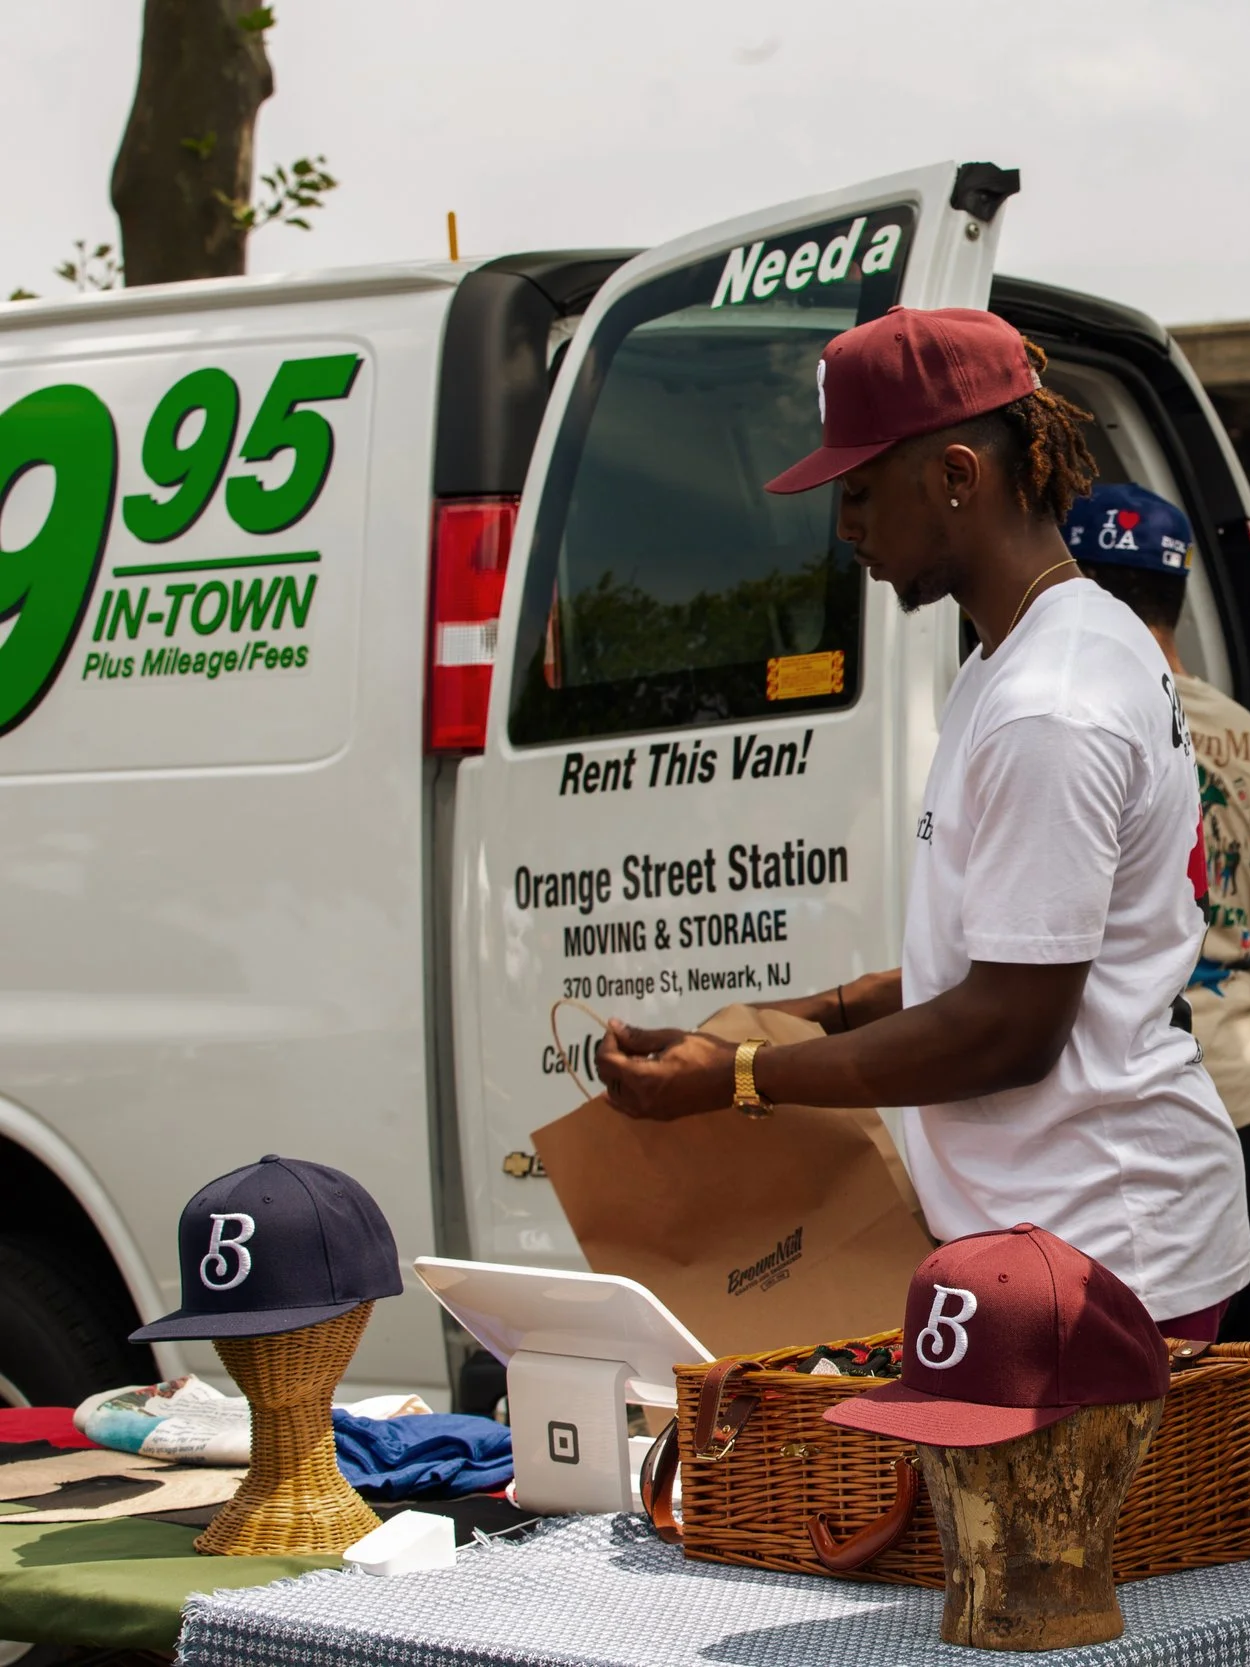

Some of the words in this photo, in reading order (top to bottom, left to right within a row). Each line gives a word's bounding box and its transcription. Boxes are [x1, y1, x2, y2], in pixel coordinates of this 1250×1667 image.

[710, 216, 868, 309] Need
[861, 223, 903, 277] a
[1098, 527, 1140, 551] CA
[1103, 508, 1119, 529] I
[92, 573, 319, 643] IN-TOWN
[82, 651, 134, 681] Plus
[141, 640, 310, 680] Mileage/Fees
[559, 748, 637, 796] Rent
[648, 739, 718, 788] This
[732, 729, 814, 781] Van!
[515, 865, 611, 915] Orange
[623, 848, 717, 901] Street
[728, 838, 848, 892] Station
[563, 920, 647, 958] MOVING
[654, 918, 671, 950] &
[679, 908, 788, 949] STORAGE
[563, 977, 592, 999] 370
[597, 973, 655, 1000] Orange
[660, 969, 684, 996] St,
[688, 964, 762, 993] Newark,
[767, 962, 791, 986] NJ
[542, 1043, 580, 1075] Call
[199, 1212, 256, 1291] B
[916, 1283, 978, 1370] B
